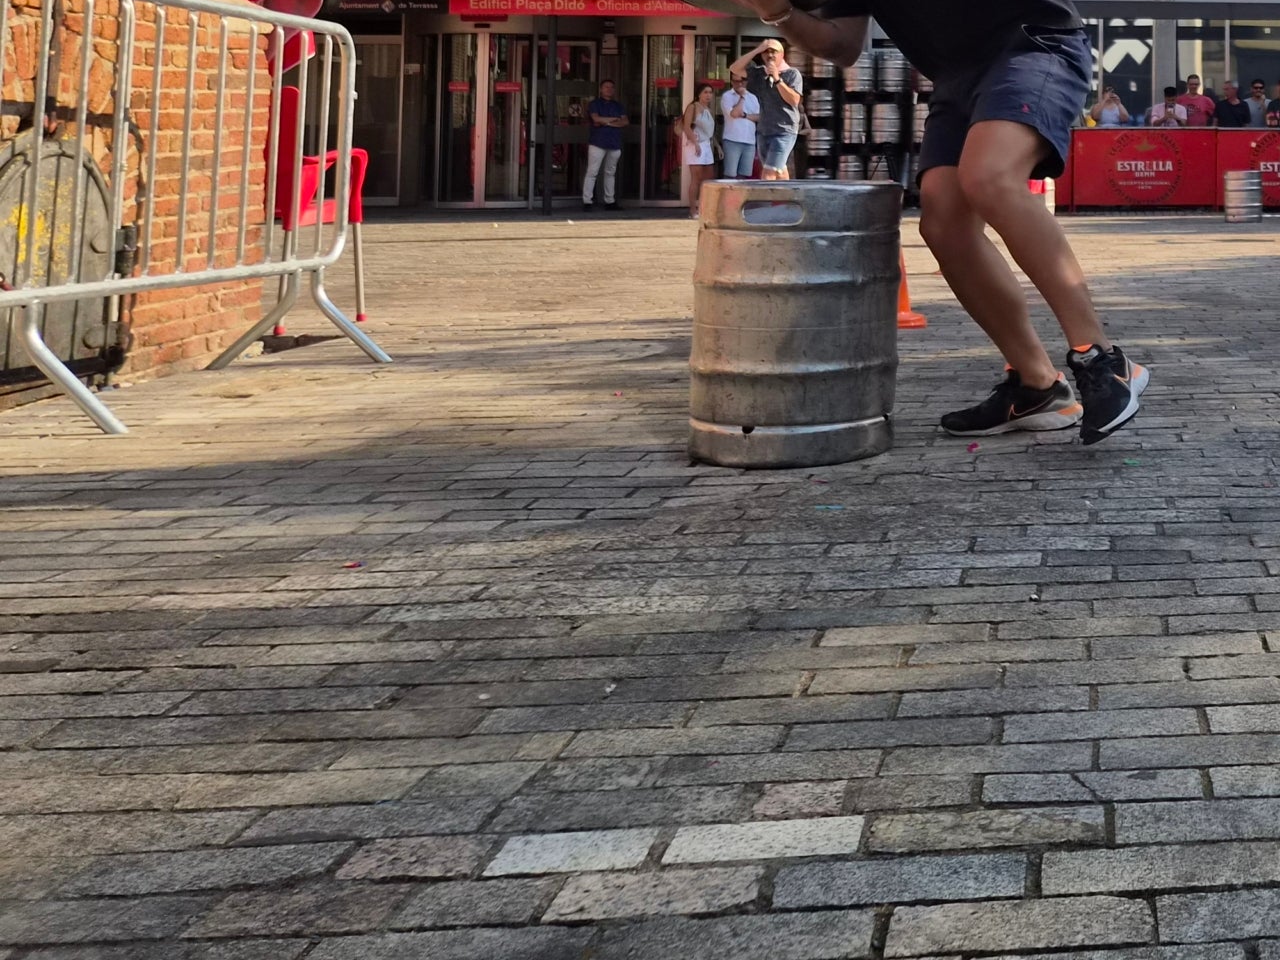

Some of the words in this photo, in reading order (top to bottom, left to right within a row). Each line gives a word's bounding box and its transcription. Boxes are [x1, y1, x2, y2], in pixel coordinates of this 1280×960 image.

[338, 1, 380, 10] Ajuntament
[408, 1, 438, 10] Terrassa
[597, 0, 639, 11] Oficina
